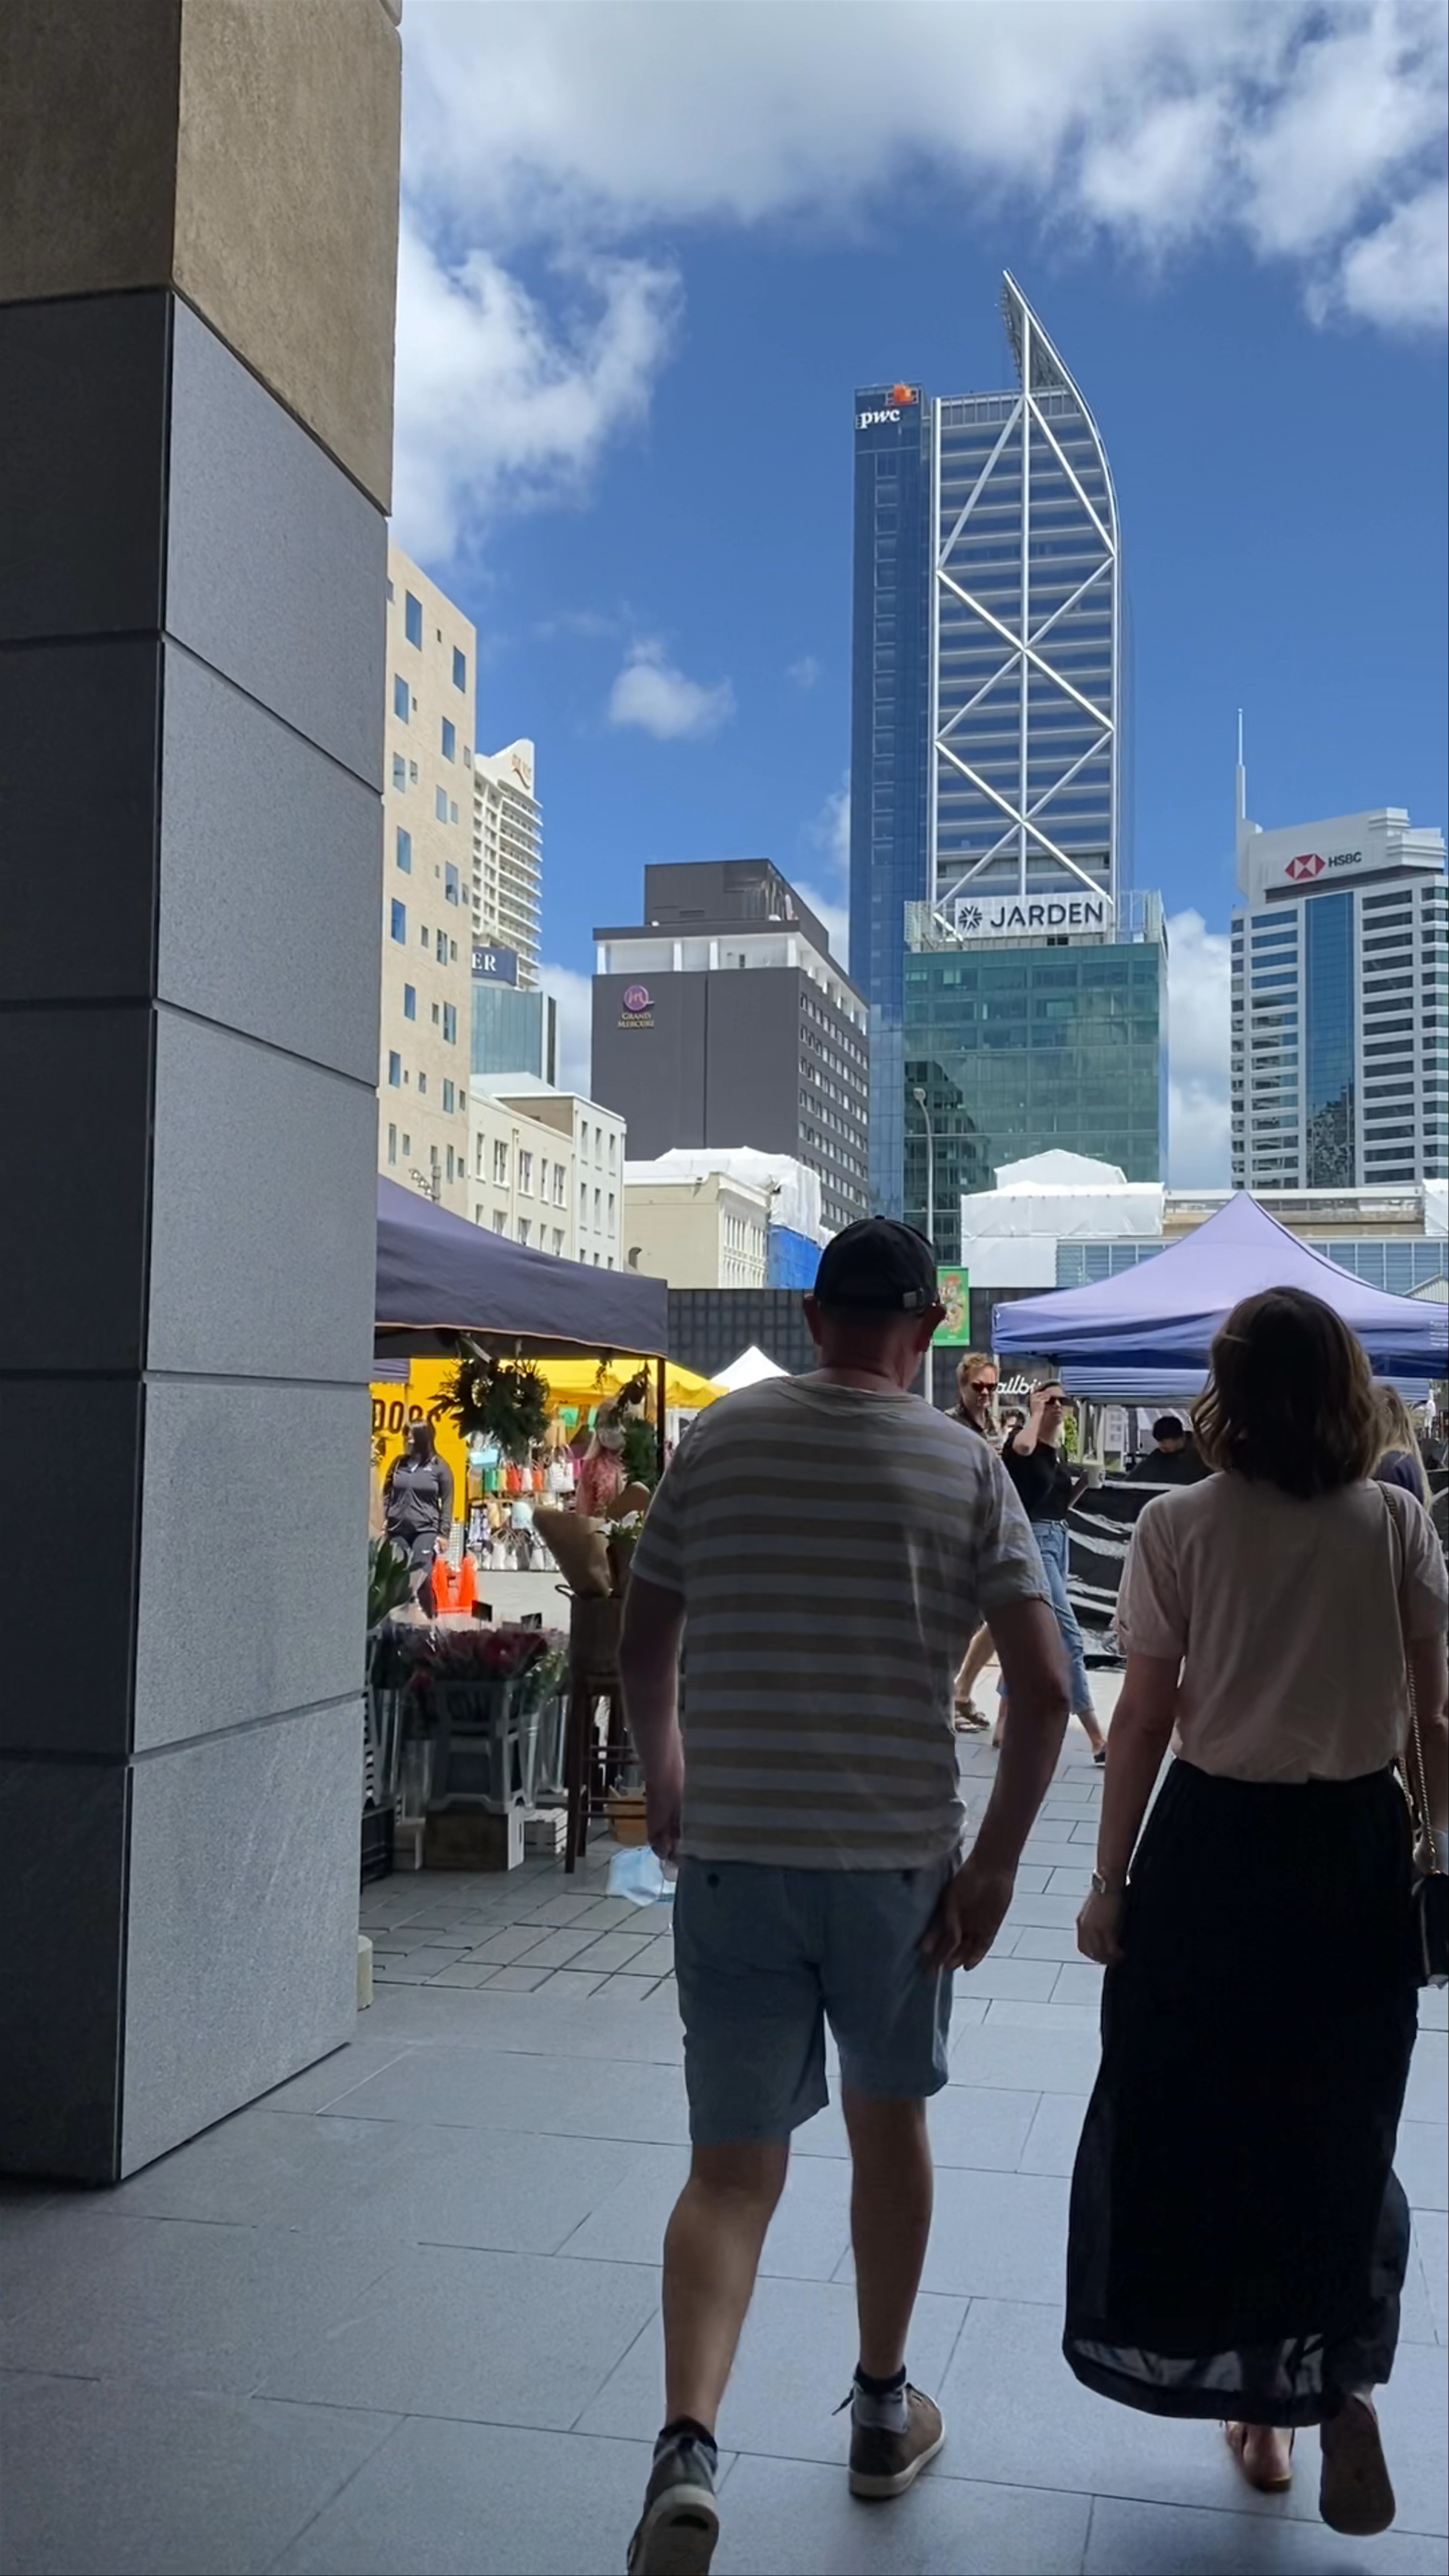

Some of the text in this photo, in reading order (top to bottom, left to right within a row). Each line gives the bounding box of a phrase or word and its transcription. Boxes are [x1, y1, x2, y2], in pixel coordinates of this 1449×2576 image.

[860, 409, 900, 429] pwc
[1328, 851, 1362, 867] HSBC
[991, 901, 1103, 928] JARDEN
[472, 952, 497, 971] ER
